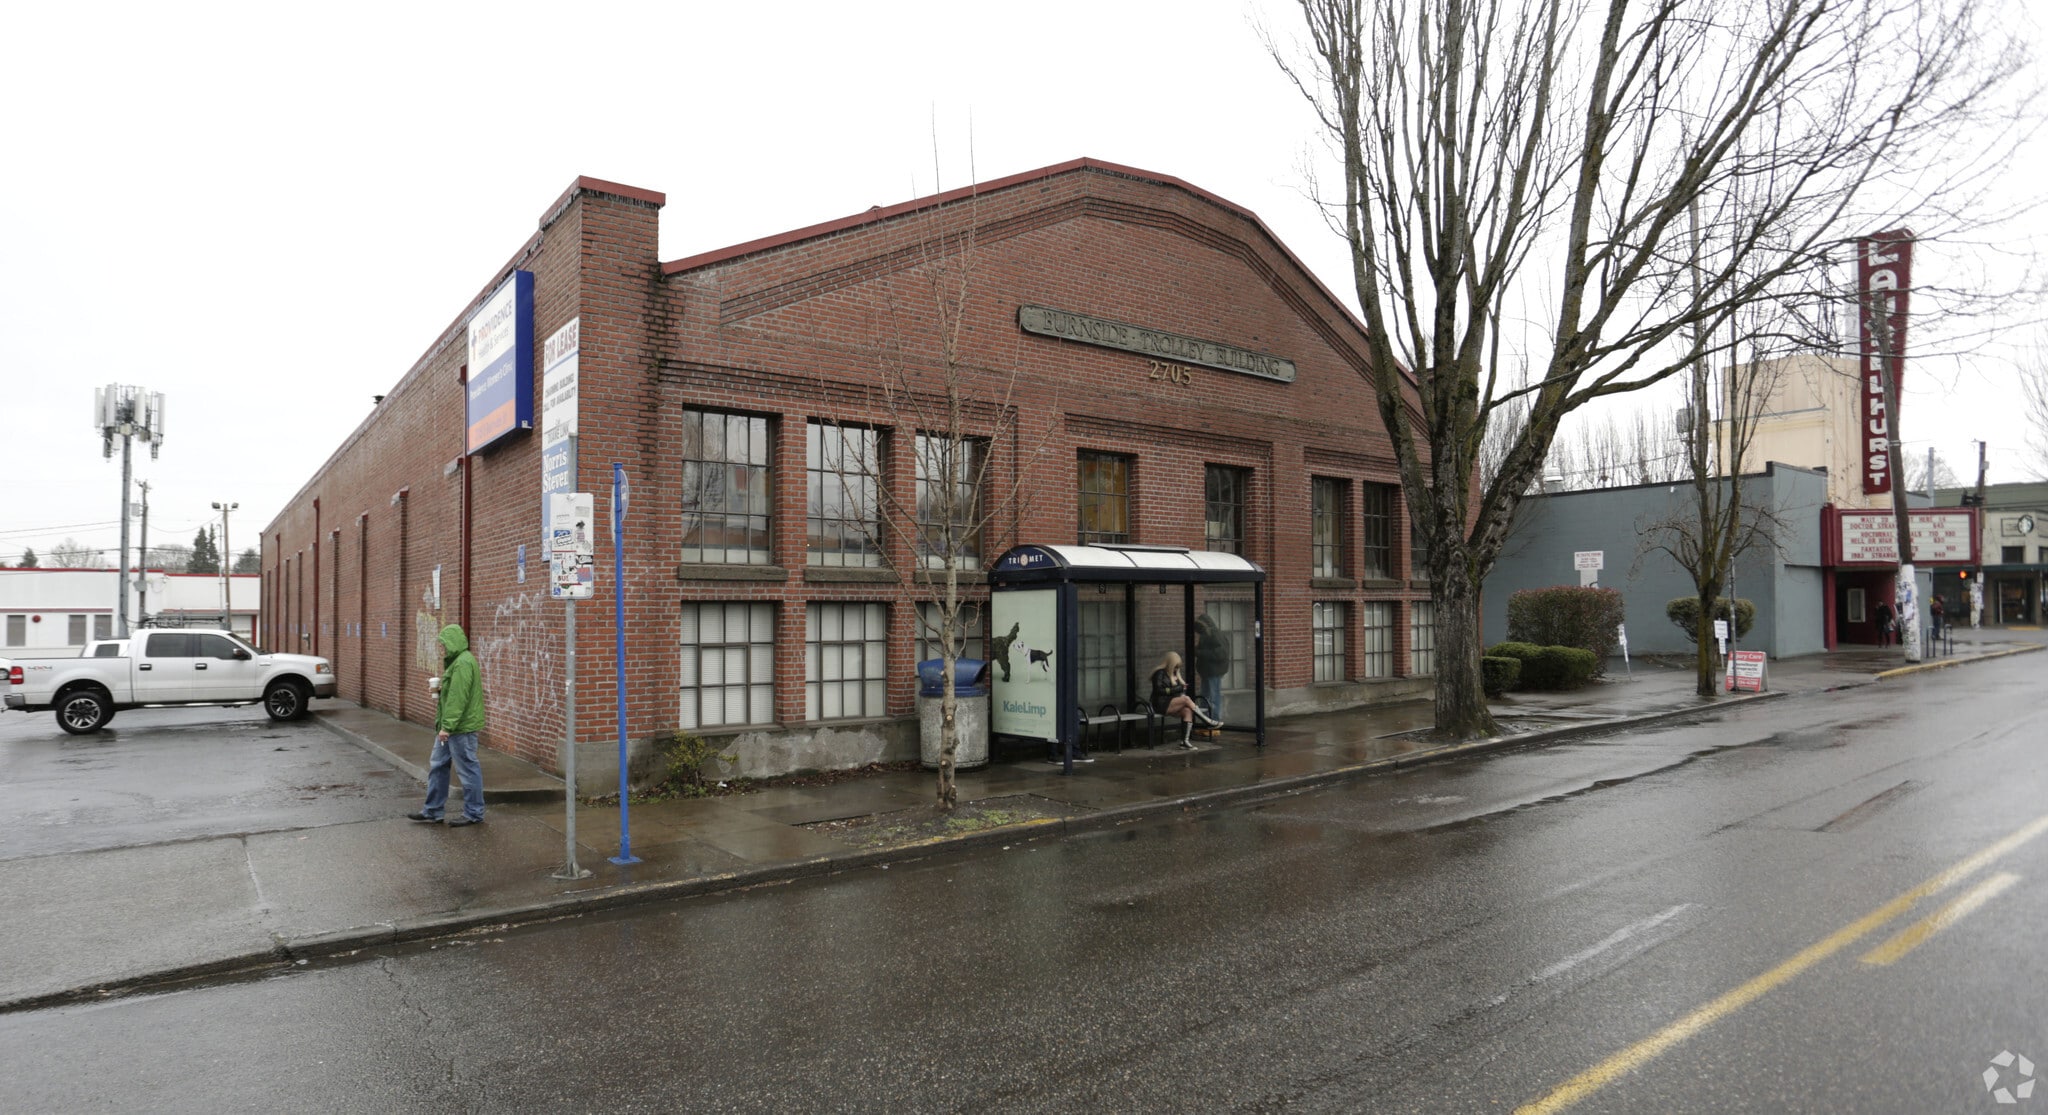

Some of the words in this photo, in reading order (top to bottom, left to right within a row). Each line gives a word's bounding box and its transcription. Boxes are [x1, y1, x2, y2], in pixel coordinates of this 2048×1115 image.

[479, 300, 512, 344] PROVIDENCE
[557, 323, 577, 358] LEASE
[1043, 311, 1128, 345] BURNSIDE
[1140, 331, 1206, 361] TROLLEY
[1216, 349, 1280, 376] BUILDING
[1150, 360, 1192, 385] 2705
[543, 447, 567, 473] Norris
[1730, 653, 1748, 661] Ijury
[1003, 700, 1047, 718] KaleLimp
